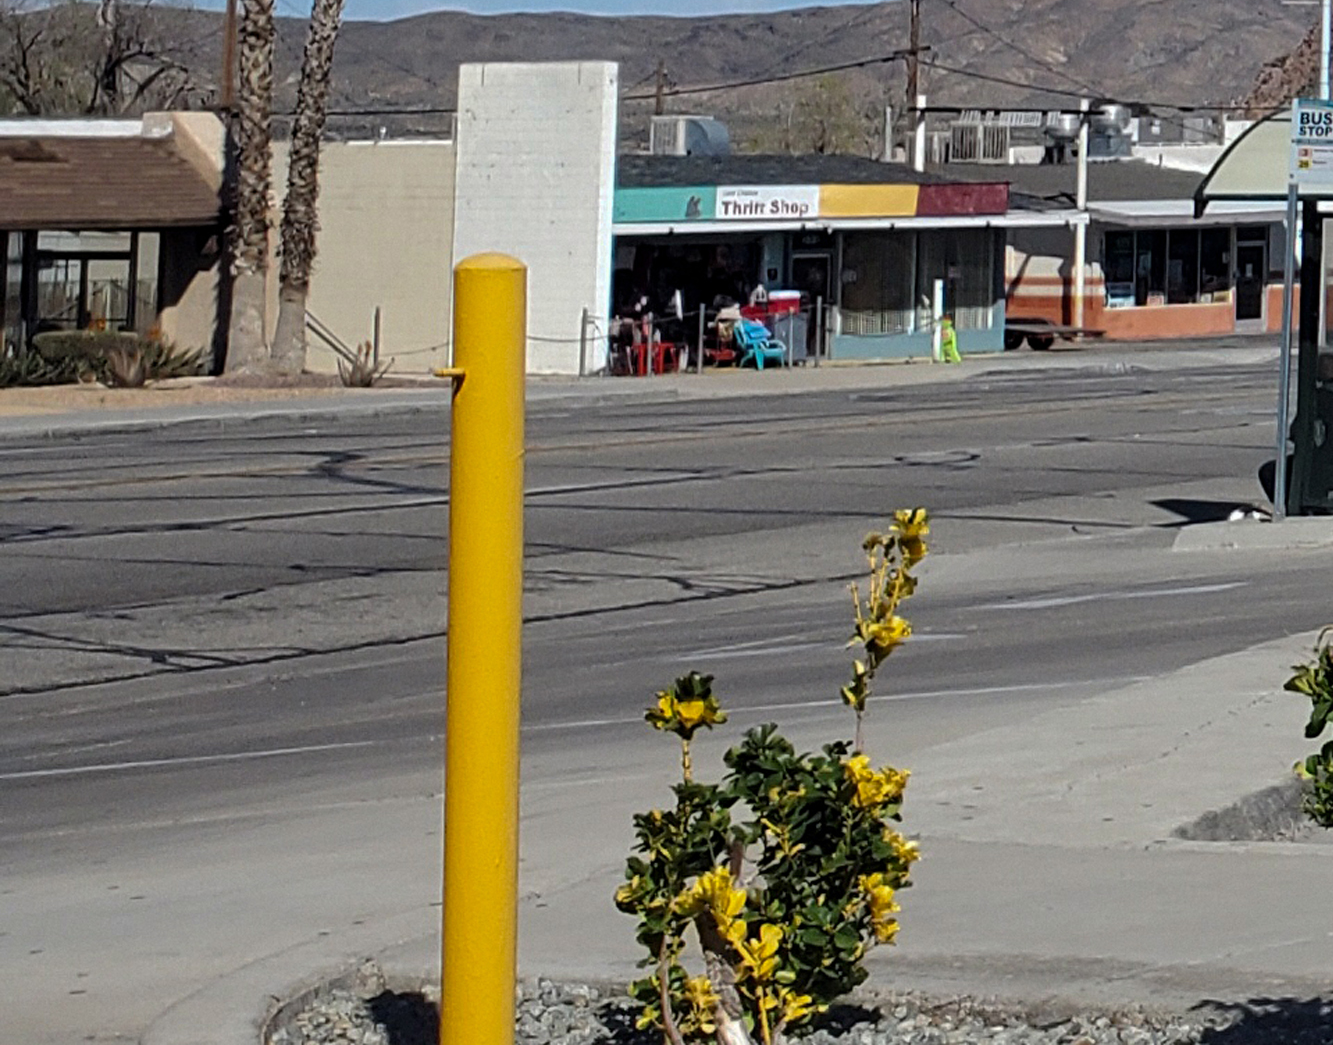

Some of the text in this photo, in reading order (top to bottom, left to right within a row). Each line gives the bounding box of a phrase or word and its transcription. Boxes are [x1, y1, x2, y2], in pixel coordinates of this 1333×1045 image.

[1300, 111, 1333, 126] BUS
[1298, 126, 1333, 137] STOP
[721, 199, 809, 217] Thrift Shop
